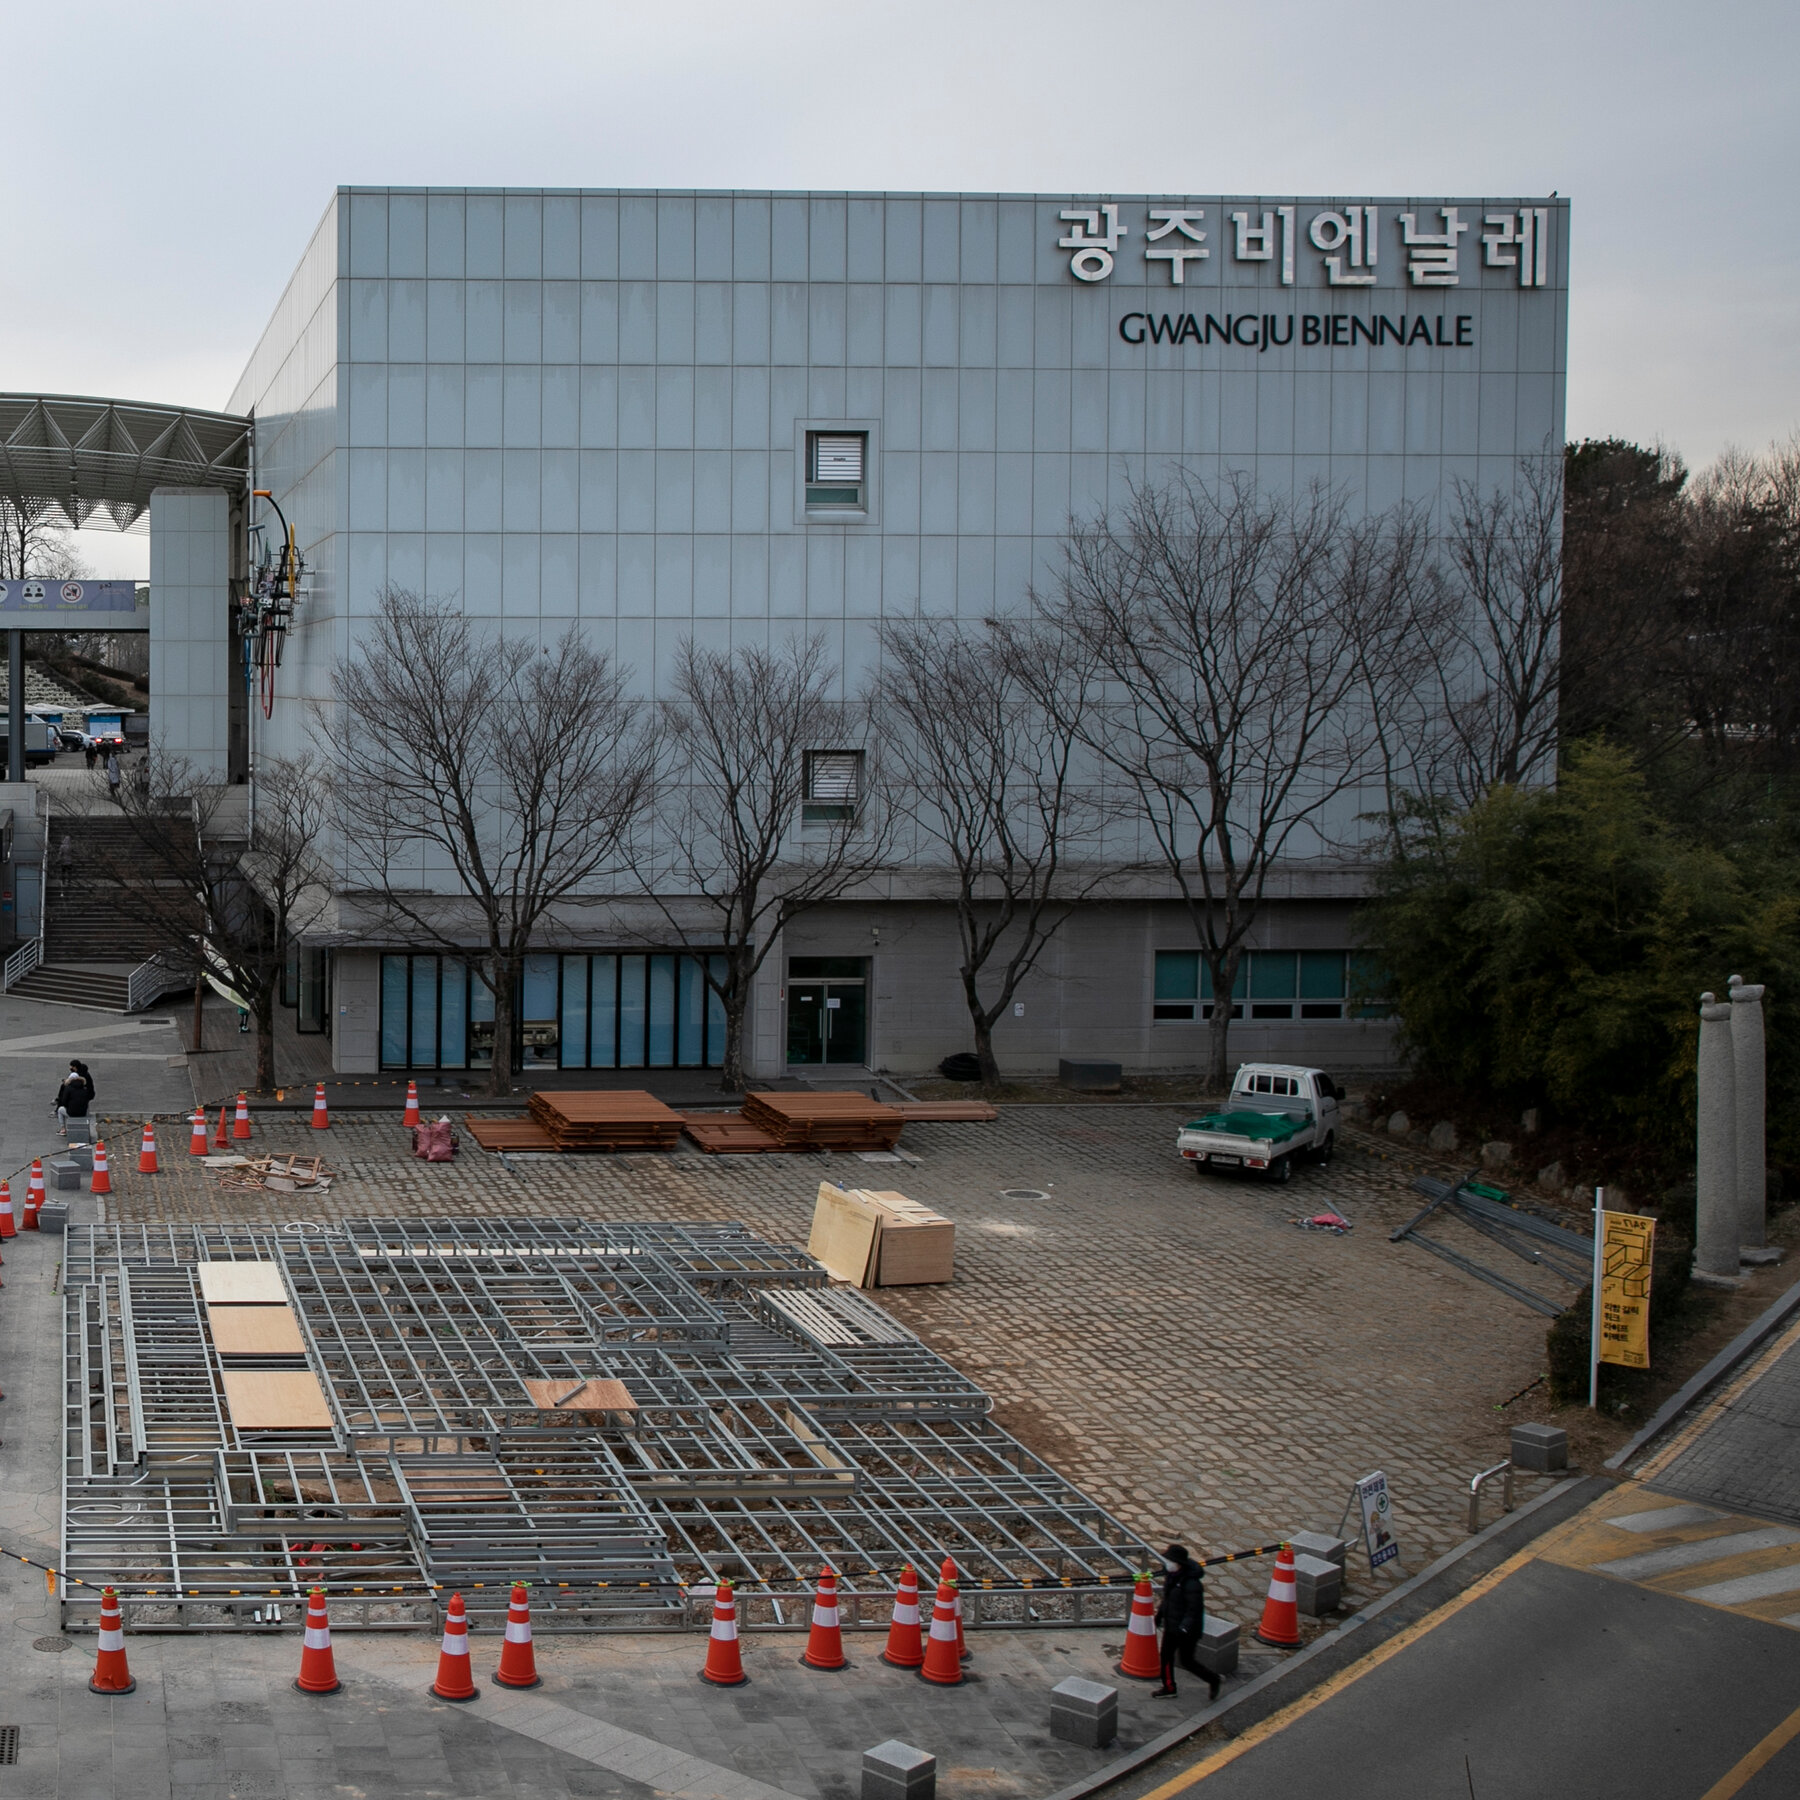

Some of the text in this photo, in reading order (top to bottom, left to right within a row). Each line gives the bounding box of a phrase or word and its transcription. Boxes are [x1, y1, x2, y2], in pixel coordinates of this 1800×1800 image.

[1058, 204, 1548, 287] 광주비엔날레
[1119, 312, 1473, 352] GWANGJU BIENNALE
[1603, 1322, 1629, 1333] 라이프
